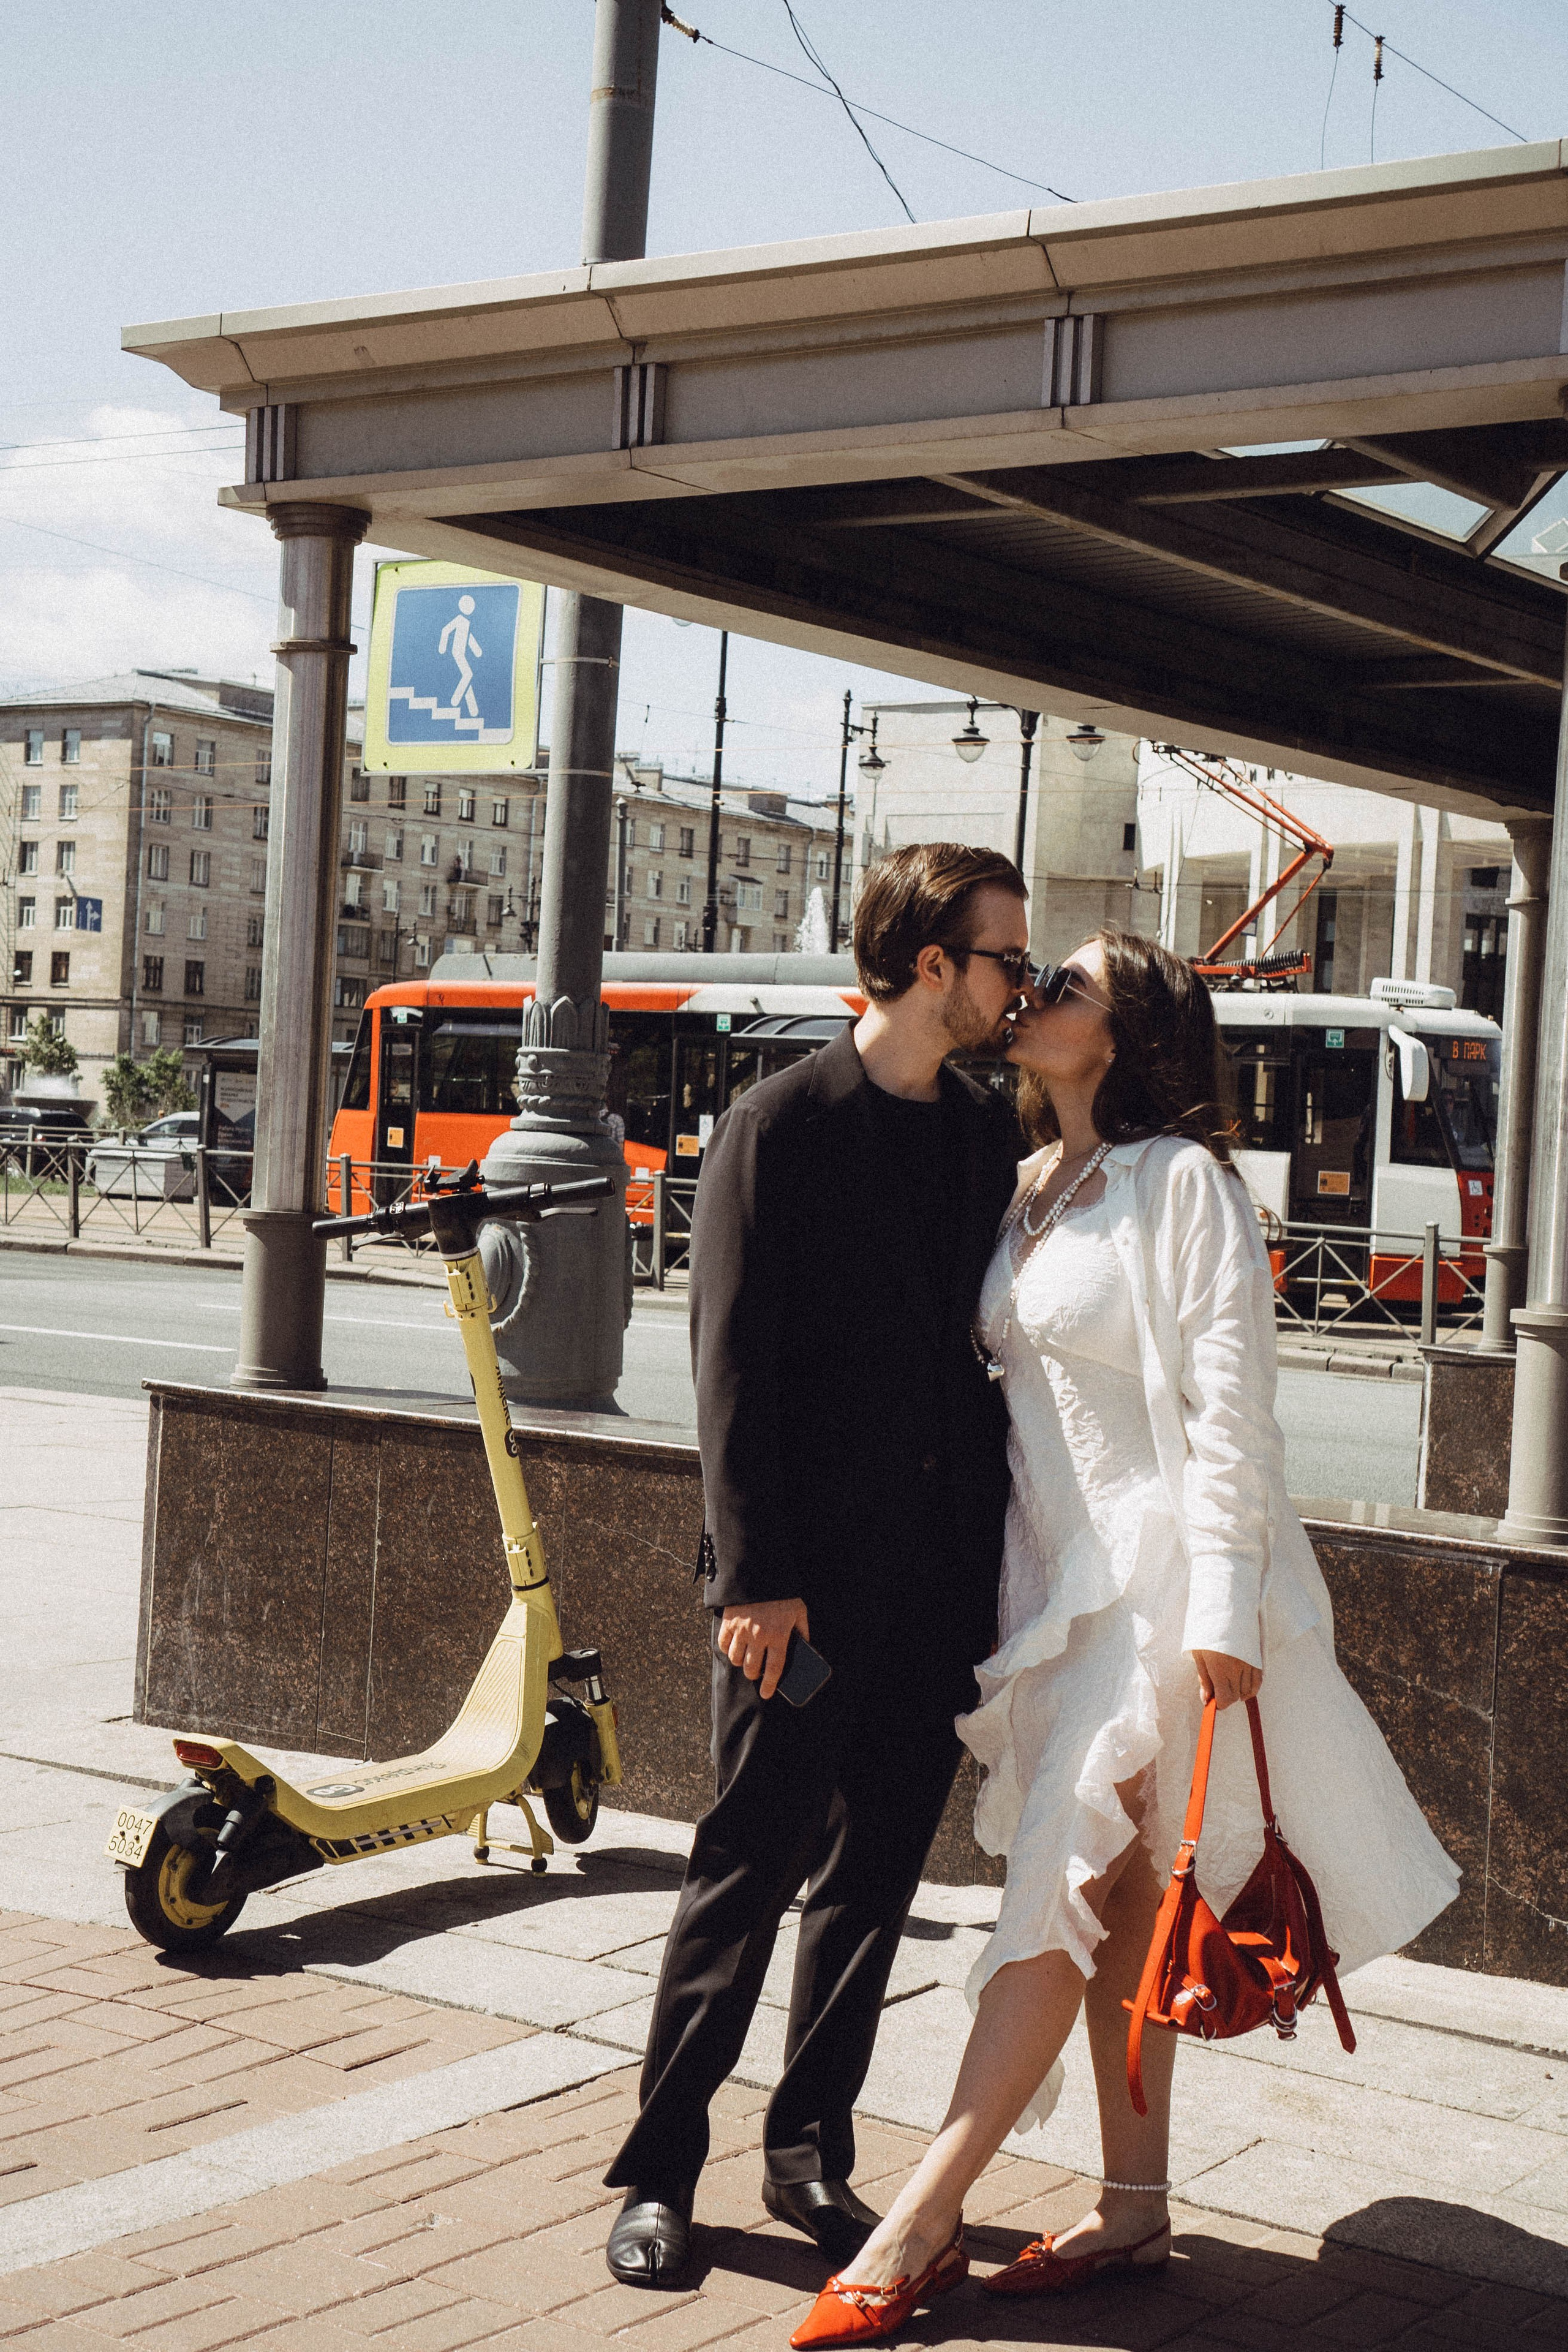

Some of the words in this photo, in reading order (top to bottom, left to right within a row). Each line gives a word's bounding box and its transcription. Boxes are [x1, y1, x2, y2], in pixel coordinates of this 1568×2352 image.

[1452, 1041, 1459, 1059] В
[1463, 1042, 1487, 1061] ПАРК
[118, 1812, 153, 1834] 0047
[108, 1836, 143, 1859] 5034
